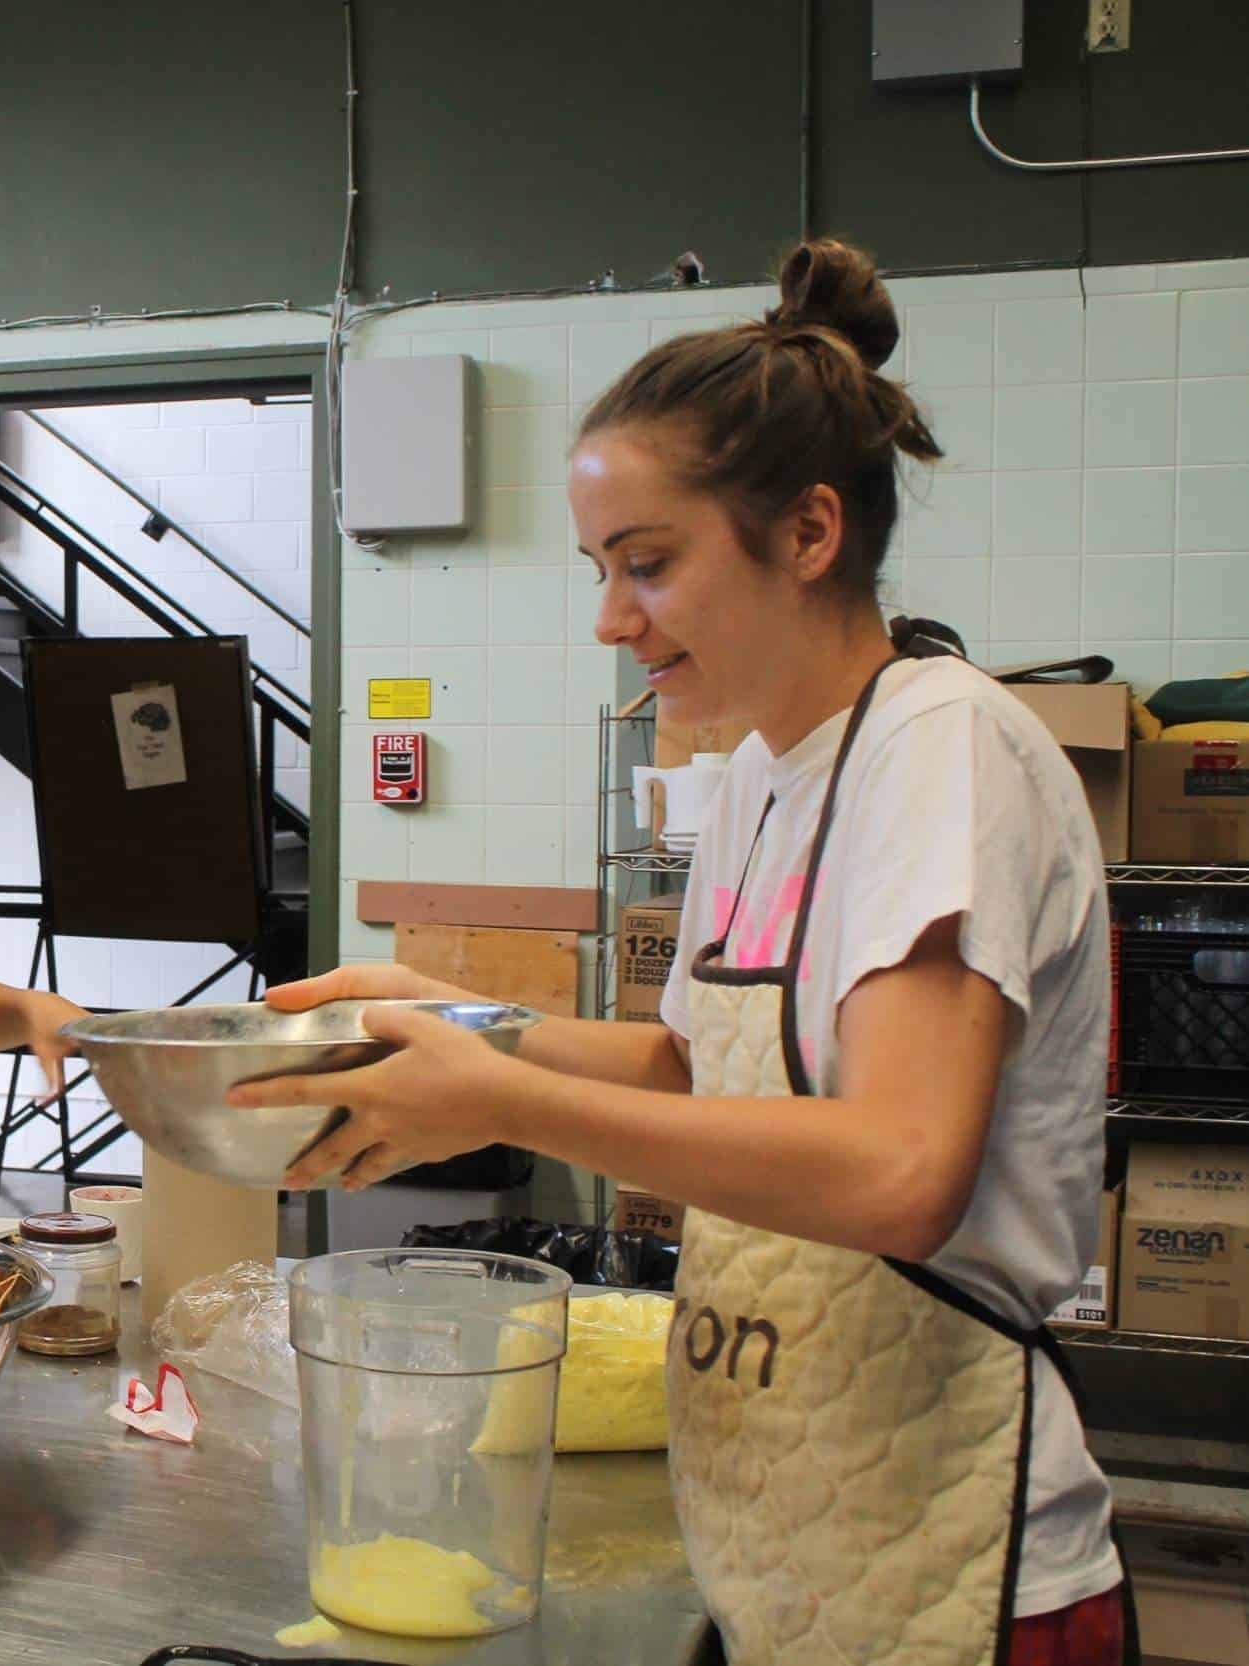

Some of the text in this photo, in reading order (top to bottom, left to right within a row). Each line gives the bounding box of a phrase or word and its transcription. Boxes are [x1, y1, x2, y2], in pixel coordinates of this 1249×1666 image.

[376, 736, 415, 751] FIRE
[626, 935, 677, 958] 126
[634, 967, 670, 977] DOUZ
[675, 1298, 780, 1388] on
